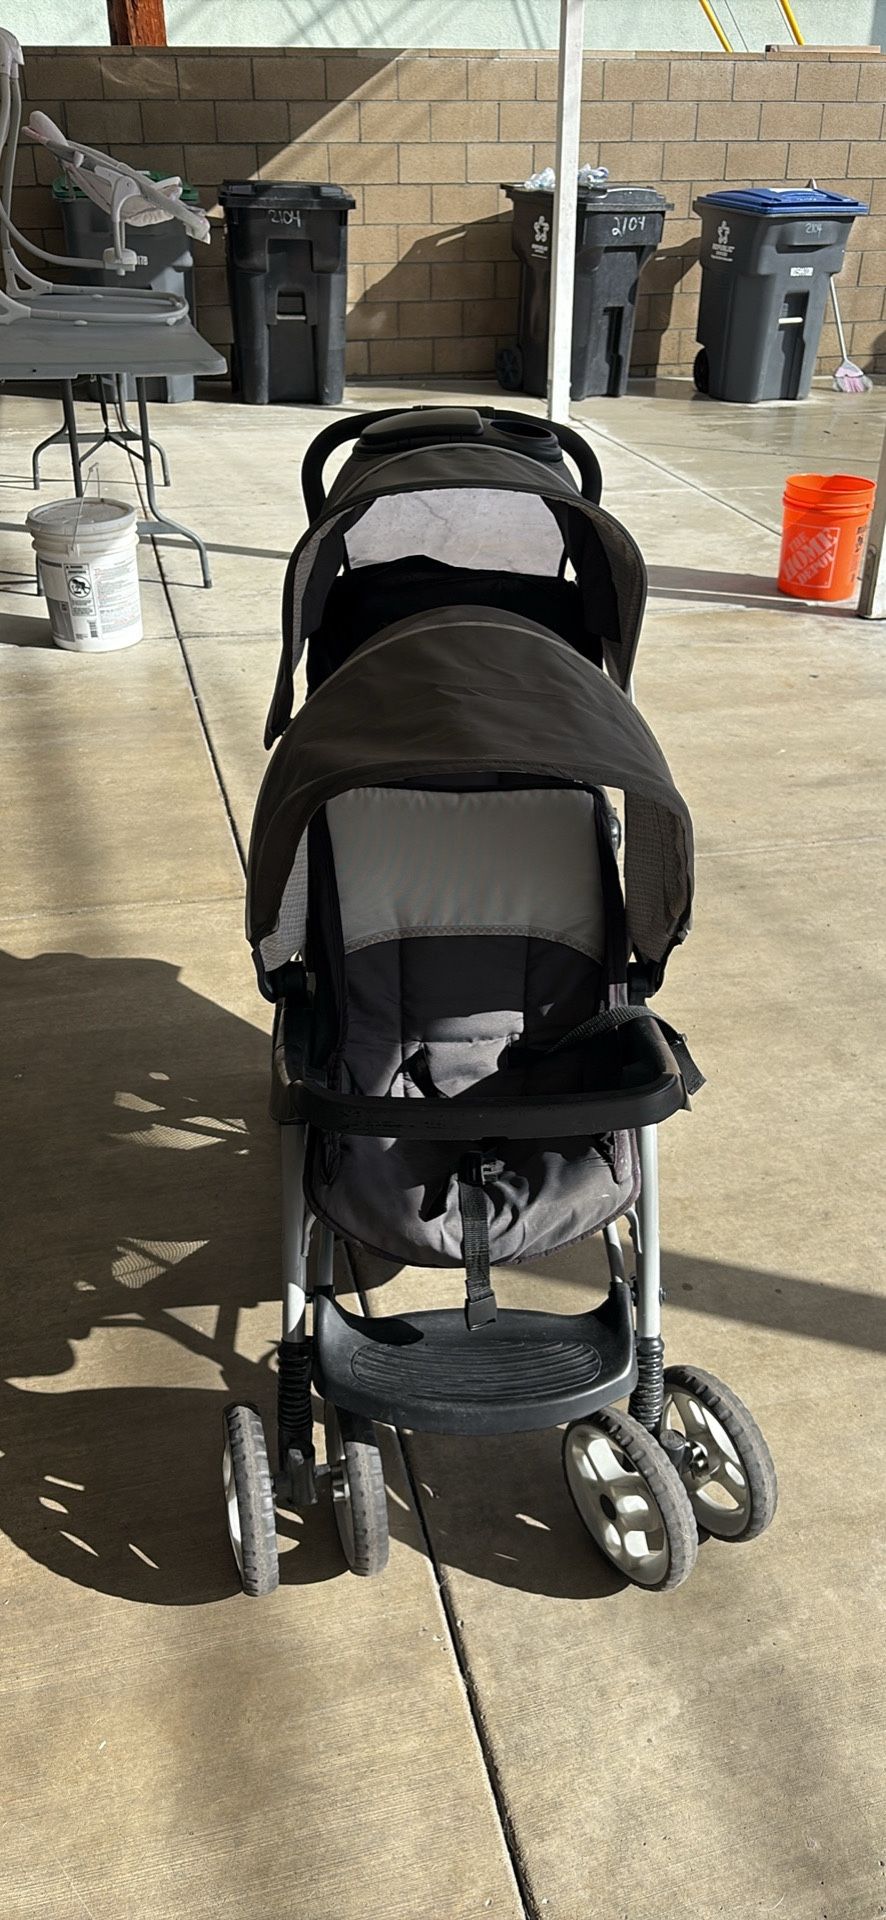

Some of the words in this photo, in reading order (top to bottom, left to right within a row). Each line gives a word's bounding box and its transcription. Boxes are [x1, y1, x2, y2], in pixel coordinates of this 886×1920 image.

[268, 209, 301, 228] 2104
[612, 216, 646, 237] 2104
[788, 531, 807, 550] THE
[783, 528, 838, 582] HOME
[797, 550, 834, 585] DEPOT
